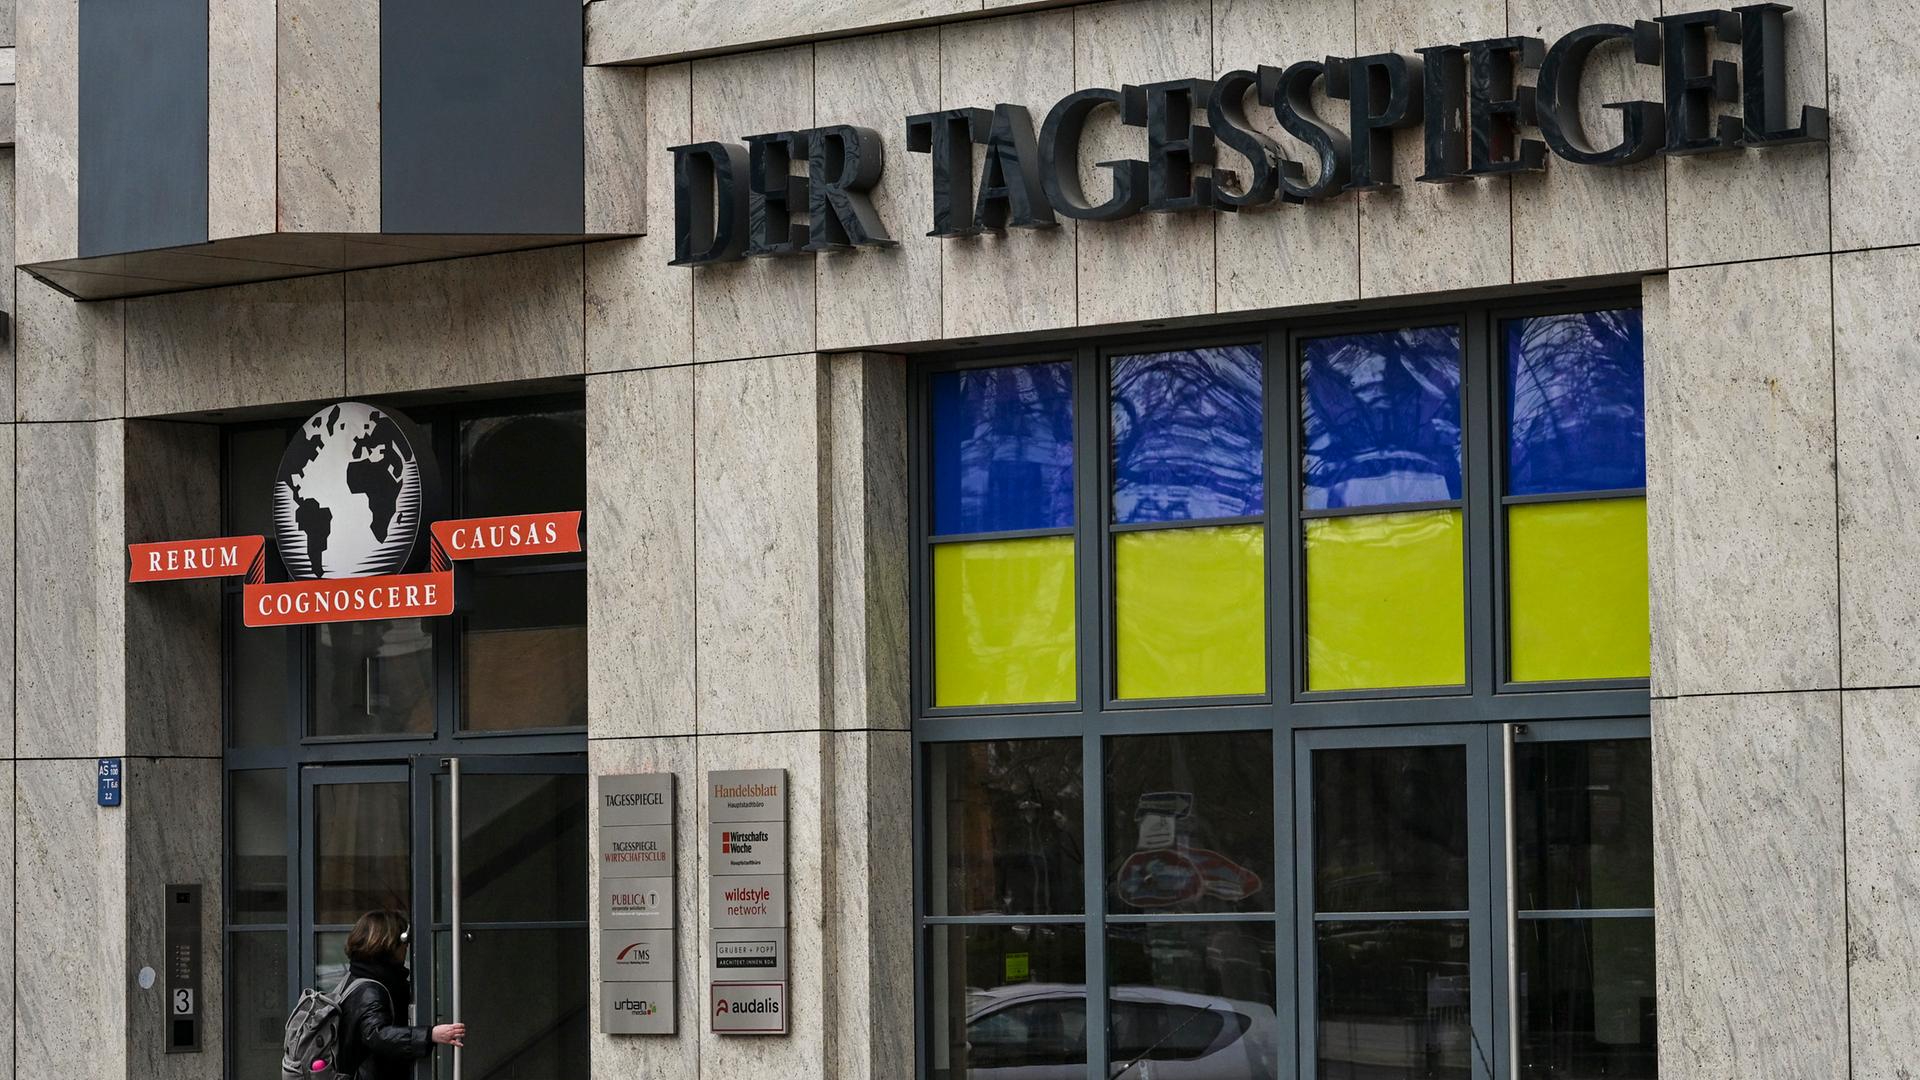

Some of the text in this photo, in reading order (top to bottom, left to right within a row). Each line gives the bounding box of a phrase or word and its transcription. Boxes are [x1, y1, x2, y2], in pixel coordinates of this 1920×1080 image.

[667, 3, 1829, 267] DER TAGESSPIEGEL
[149, 522, 558, 616] RERUM COGNOSCERE CAUSAS
[99, 765, 109, 776] AS
[714, 784, 777, 798] Handelsblatt
[605, 793, 664, 807] TAGESSPIEGEL
[728, 801, 765, 809] Hauptstadtbüro
[730, 831, 769, 842] Wirtschafts
[613, 841, 658, 852] TAGESSPIEGEL
[730, 843, 752, 854] Woche
[604, 852, 666, 863] WIRTSCHAFTSCLUB
[612, 893, 646, 906] PUBLICA
[725, 887, 770, 904] wildstyle
[727, 904, 767, 916] network
[634, 949, 650, 961] TMS
[719, 946, 747, 954] GRUBER
[176, 989, 190, 1013] 3
[614, 998, 647, 1011] urban
[732, 998, 779, 1014] audalis
